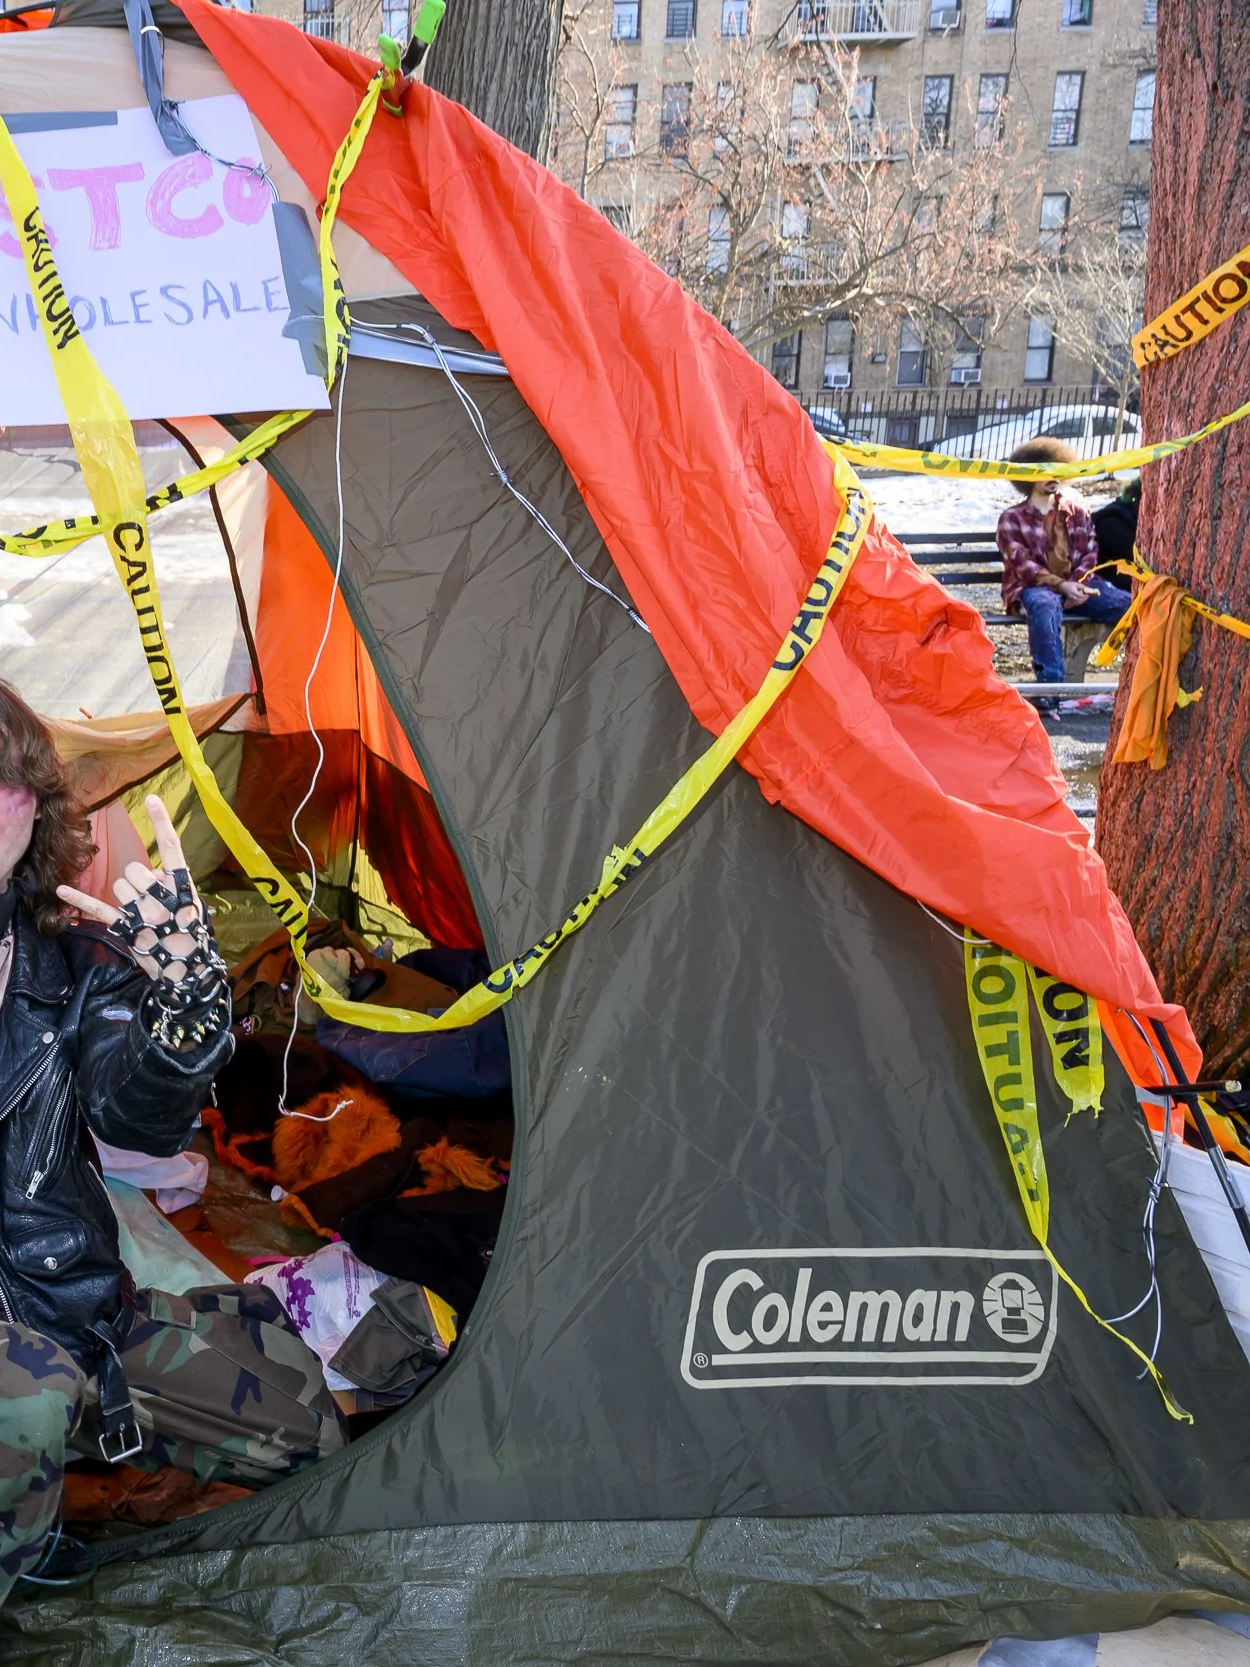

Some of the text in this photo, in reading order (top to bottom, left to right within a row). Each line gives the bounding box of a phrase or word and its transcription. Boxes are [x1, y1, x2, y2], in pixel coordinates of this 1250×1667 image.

[24, 206, 80, 350] CAUTION
[112, 521, 181, 716] CAUTION
[712, 1267, 974, 1352] Coleman
